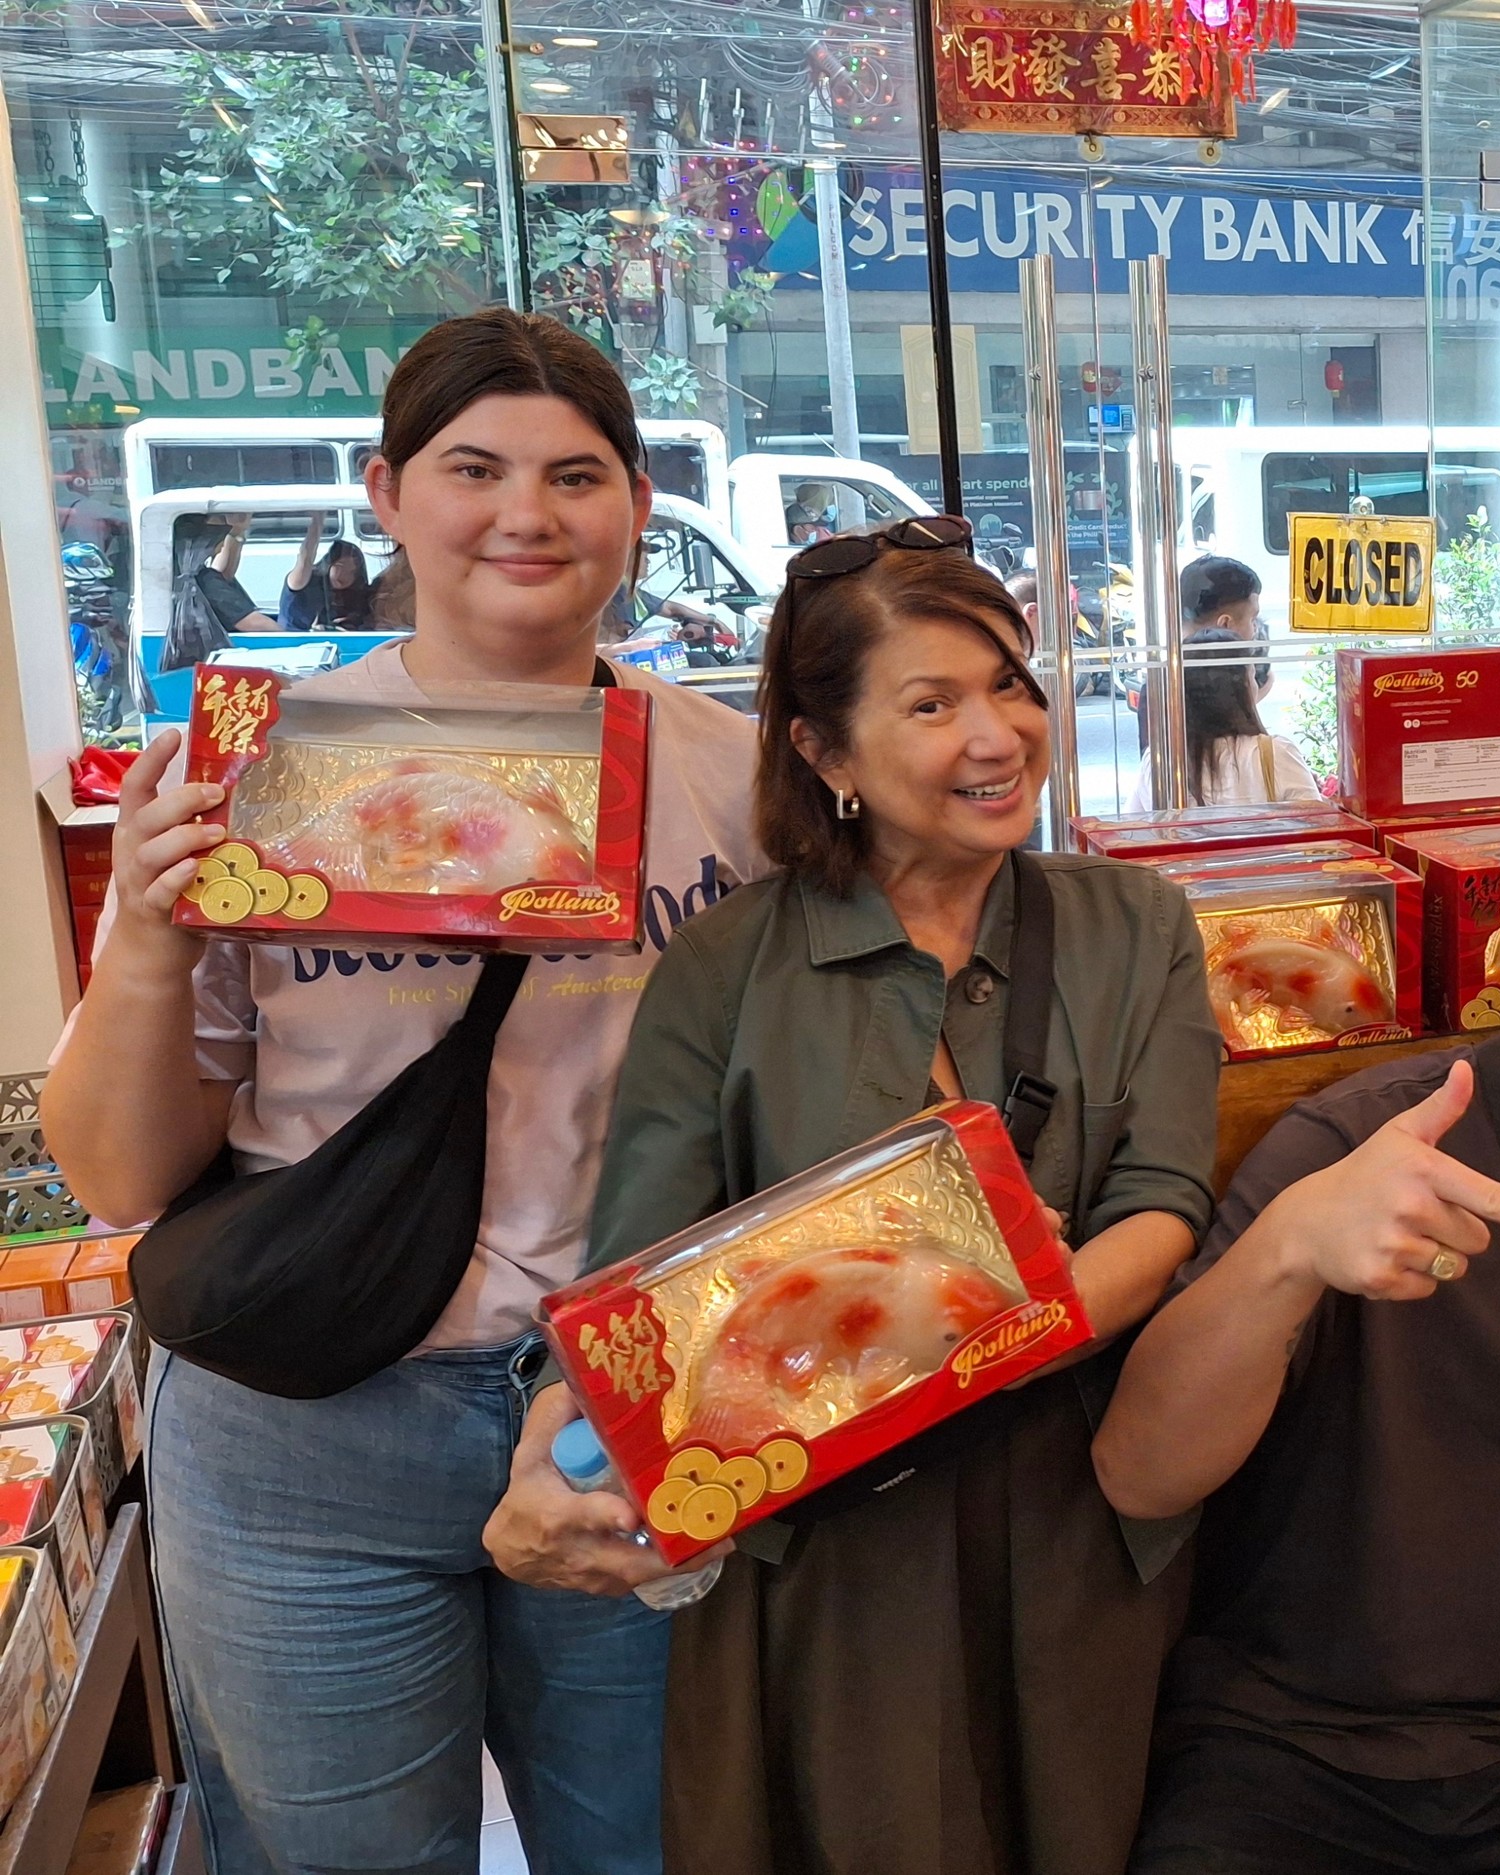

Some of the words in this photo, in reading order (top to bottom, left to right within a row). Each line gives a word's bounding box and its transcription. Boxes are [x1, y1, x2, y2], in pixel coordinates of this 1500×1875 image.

[848, 187, 1184, 260] SECURITY
[1202, 198, 1388, 265] BANK
[43, 347, 408, 402] LANDBAN
[962, 478, 983, 490] art
[986, 476, 1031, 492] spend
[1303, 537, 1423, 607] CLOSED
[1456, 670, 1479, 688] 50
[387, 985, 437, 1006] Free
[549, 969, 647, 998] Amsterd
